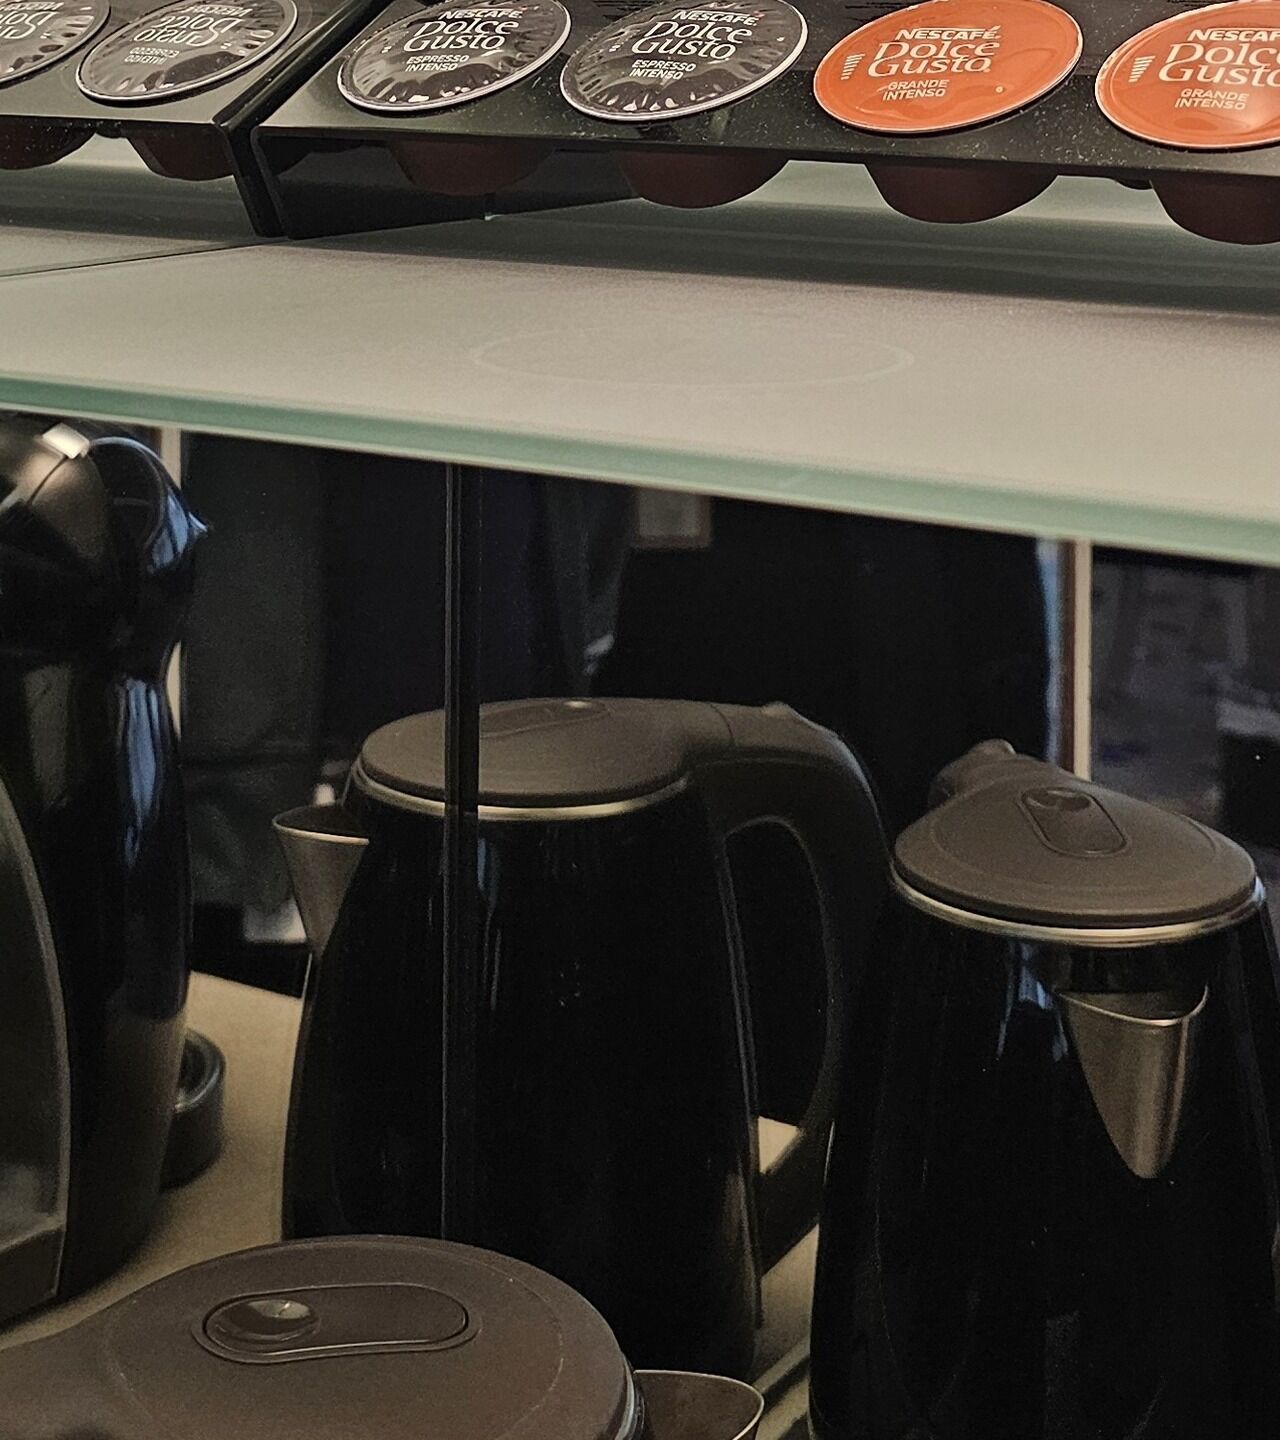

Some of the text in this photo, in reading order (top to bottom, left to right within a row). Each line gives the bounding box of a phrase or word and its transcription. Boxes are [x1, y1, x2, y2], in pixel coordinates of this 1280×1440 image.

[413, 18, 520, 38] Dolce
[643, 20, 753, 45] Dolce
[403, 34, 506, 53] Gusto
[631, 36, 737, 60] Gusto
[873, 40, 1000, 61] Dolce
[406, 54, 470, 65] ESPRESSO
[631, 59, 697, 73] ESPRESSO
[405, 62, 459, 73] INTENSO
[867, 56, 992, 78] Gusto
[629, 68, 684, 81] INTENSO
[887, 79, 950, 91] GRANDE
[882, 88, 947, 102] INTENSO
[1180, 88, 1250, 102] GRANDE
[1174, 97, 1247, 111] INTENSO
